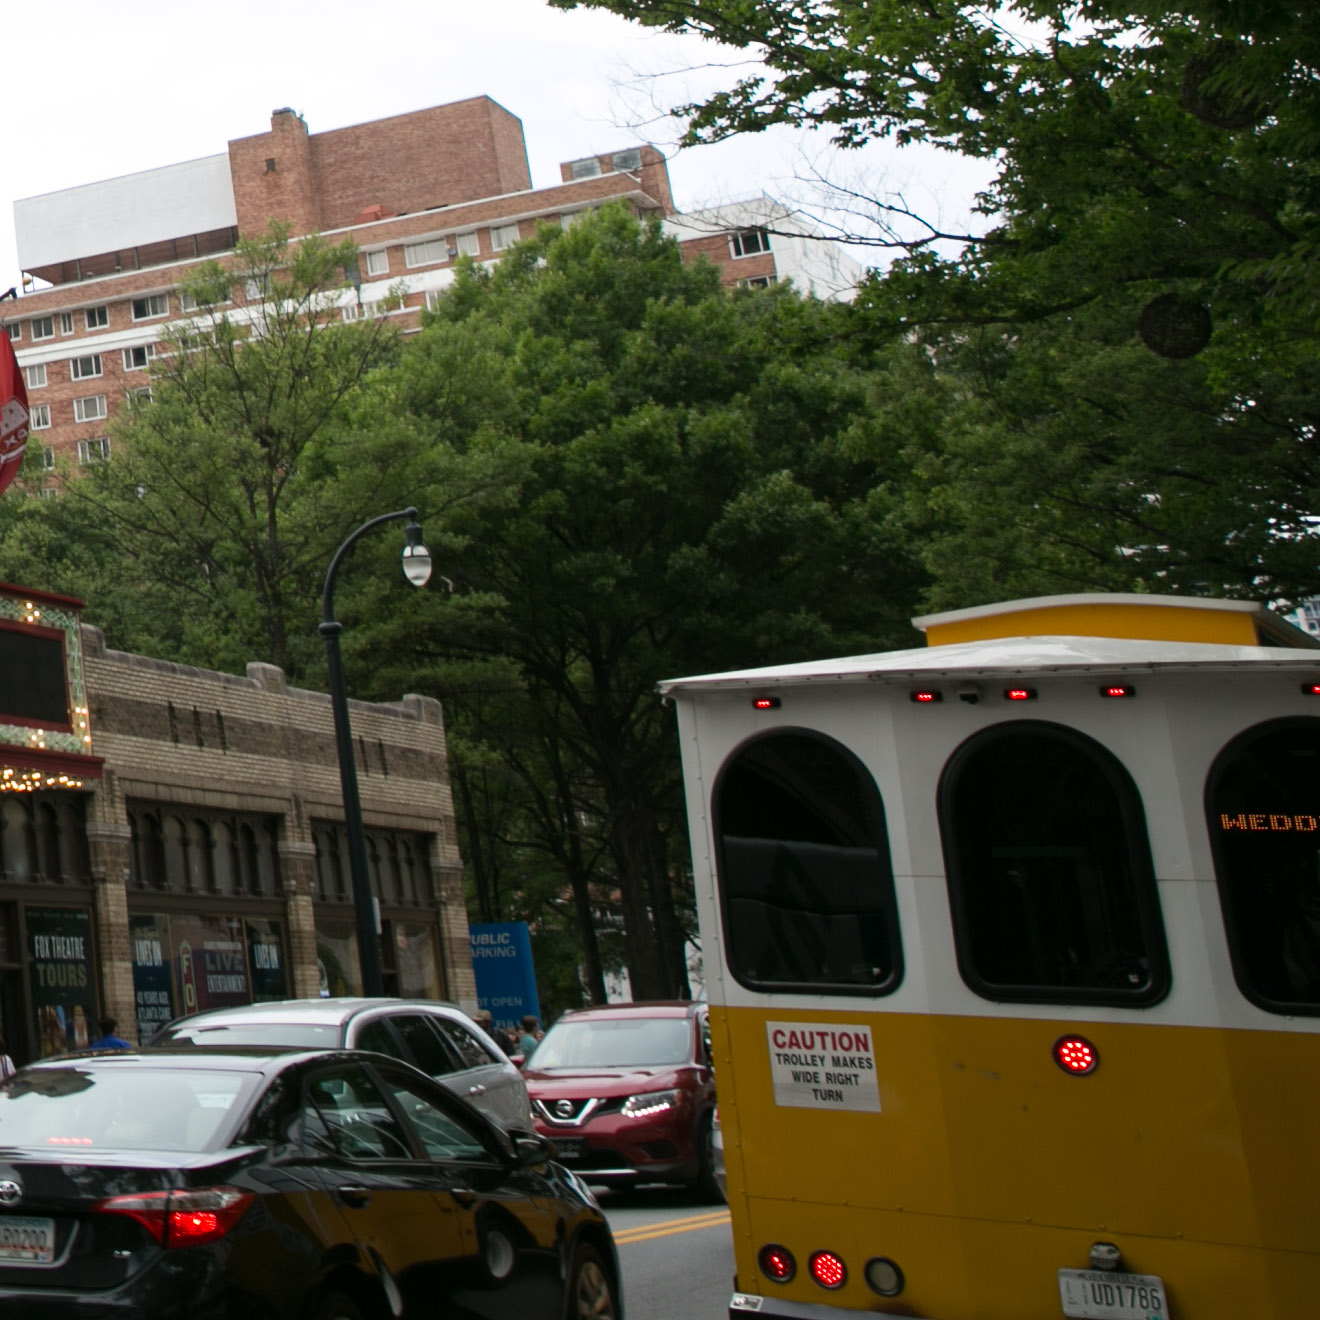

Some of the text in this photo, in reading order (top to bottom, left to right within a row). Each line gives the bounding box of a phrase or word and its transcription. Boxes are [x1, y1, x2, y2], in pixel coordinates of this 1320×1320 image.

[1221, 813, 1320, 831] WEDD
[34, 934, 86, 960] FOX THEATRE
[471, 932, 511, 946] UBLIC
[135, 939, 153, 966] LIVES
[471, 945, 516, 959] ARKING
[205, 952, 245, 971] LIVE
[36, 963, 88, 988] TOURS
[491, 996, 523, 1007] OPEN
[772, 1029, 869, 1052] CAUTION
[775, 1053, 873, 1069] TROLLEY MAKES
[791, 1070, 860, 1086] WIDE RIGHT
[812, 1088, 844, 1102] TURN
[1082, 1271, 1144, 1285] GEORGIA
[1090, 1282, 1161, 1311] UD1786
